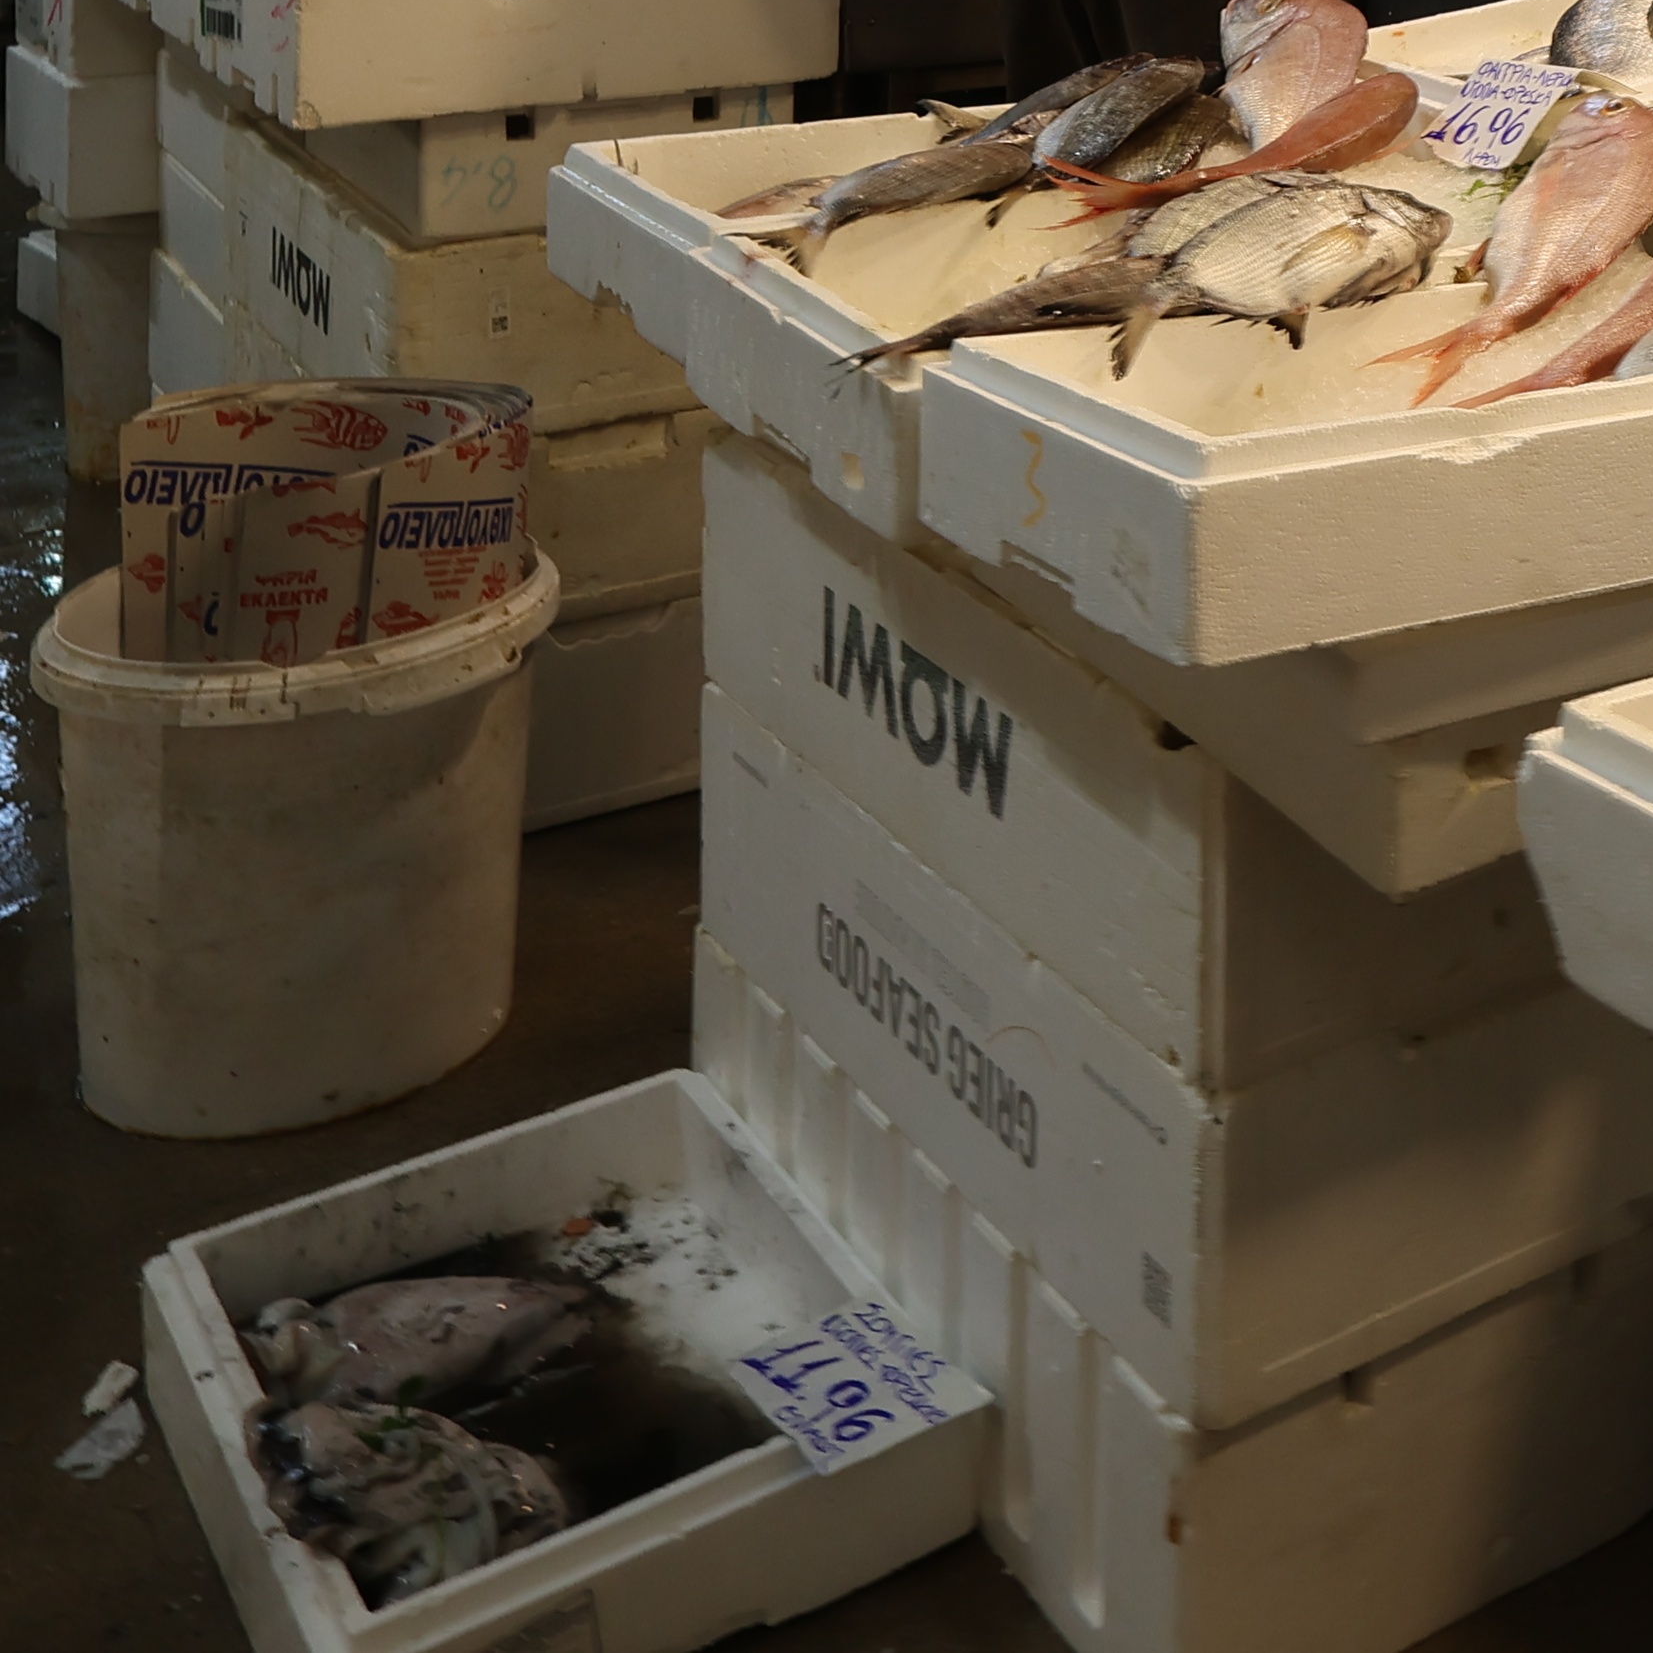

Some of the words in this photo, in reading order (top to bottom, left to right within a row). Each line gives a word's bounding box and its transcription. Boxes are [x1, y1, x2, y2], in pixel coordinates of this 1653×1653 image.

[1420, 102, 1531, 149] 16.96
[271, 225, 331, 337] MOWI
[822, 585, 1014, 822] MOWI
[816, 902, 940, 1077] SEAFOOD
[738, 1339, 896, 1442] 11.96
